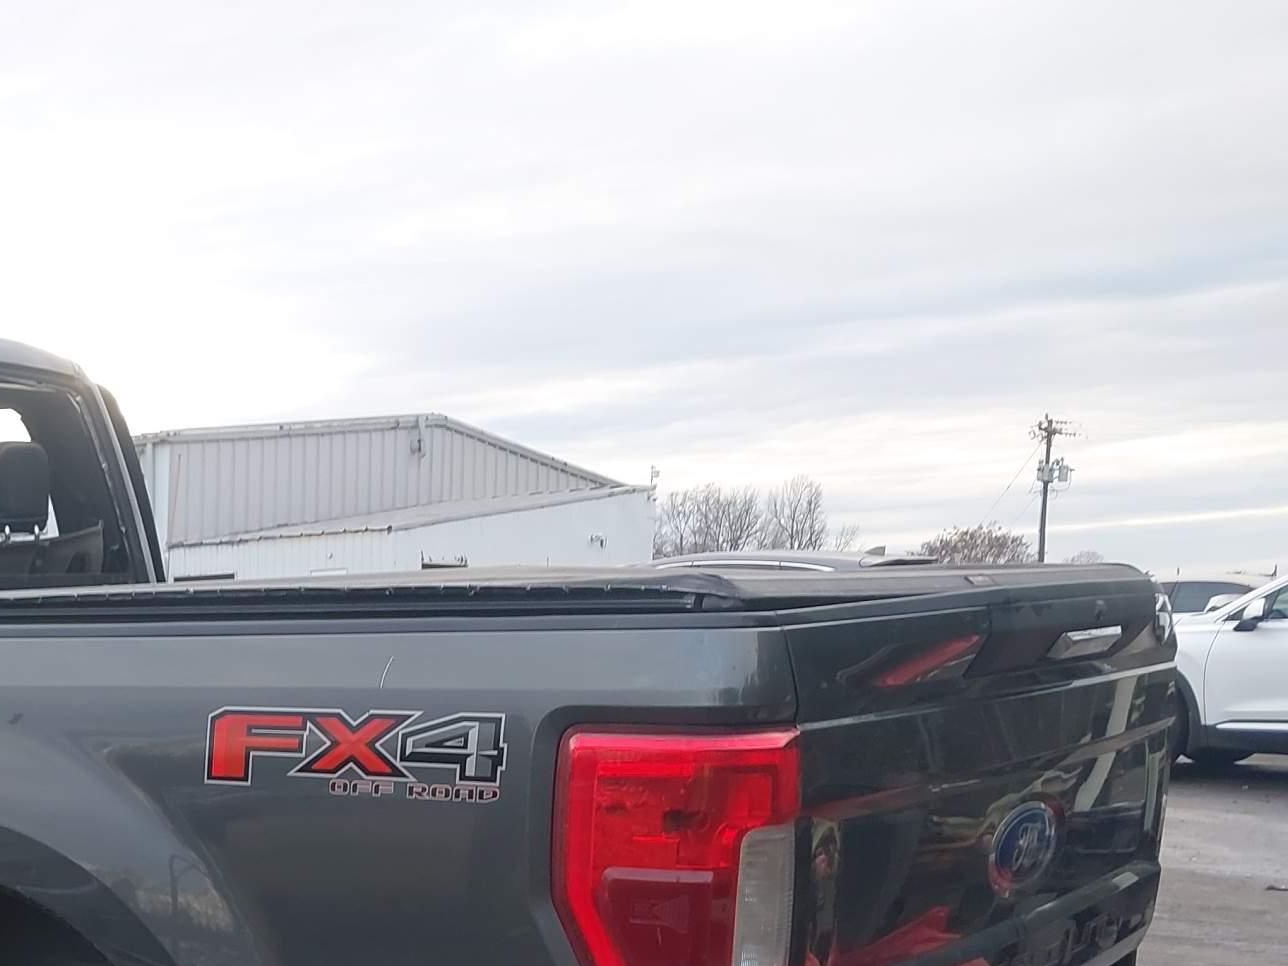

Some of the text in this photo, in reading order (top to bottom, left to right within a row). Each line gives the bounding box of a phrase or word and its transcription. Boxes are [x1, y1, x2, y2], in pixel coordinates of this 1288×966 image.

[204, 706, 507, 786] FX4
[328, 779, 500, 804] OFF ROAD
